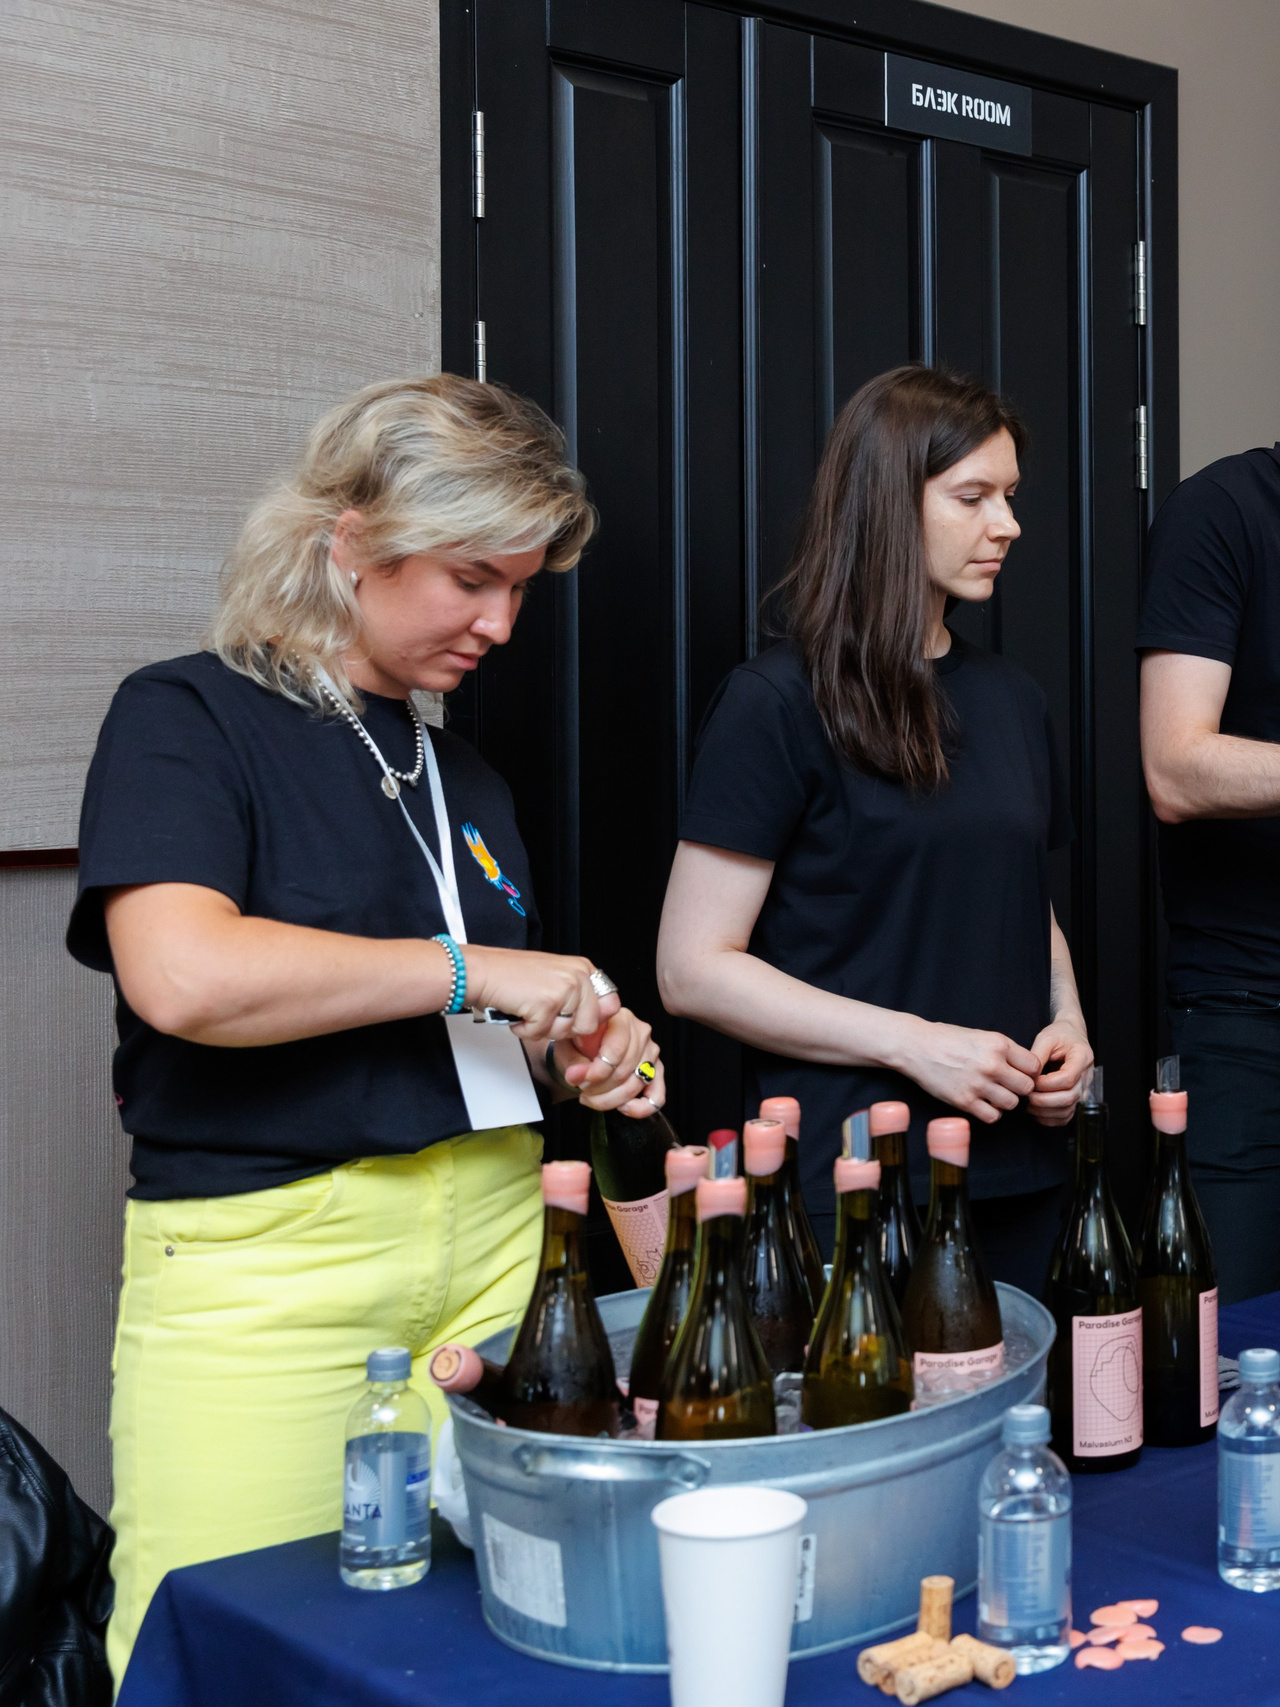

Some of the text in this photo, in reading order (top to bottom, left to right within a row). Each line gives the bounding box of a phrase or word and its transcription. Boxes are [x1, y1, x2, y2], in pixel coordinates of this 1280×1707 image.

[911, 83, 1011, 127] БЛЭК ROOM
[616, 1203, 649, 1213] Garage
[1078, 1319, 1120, 1330] Paradise
[920, 1357, 965, 1369] Paradise
